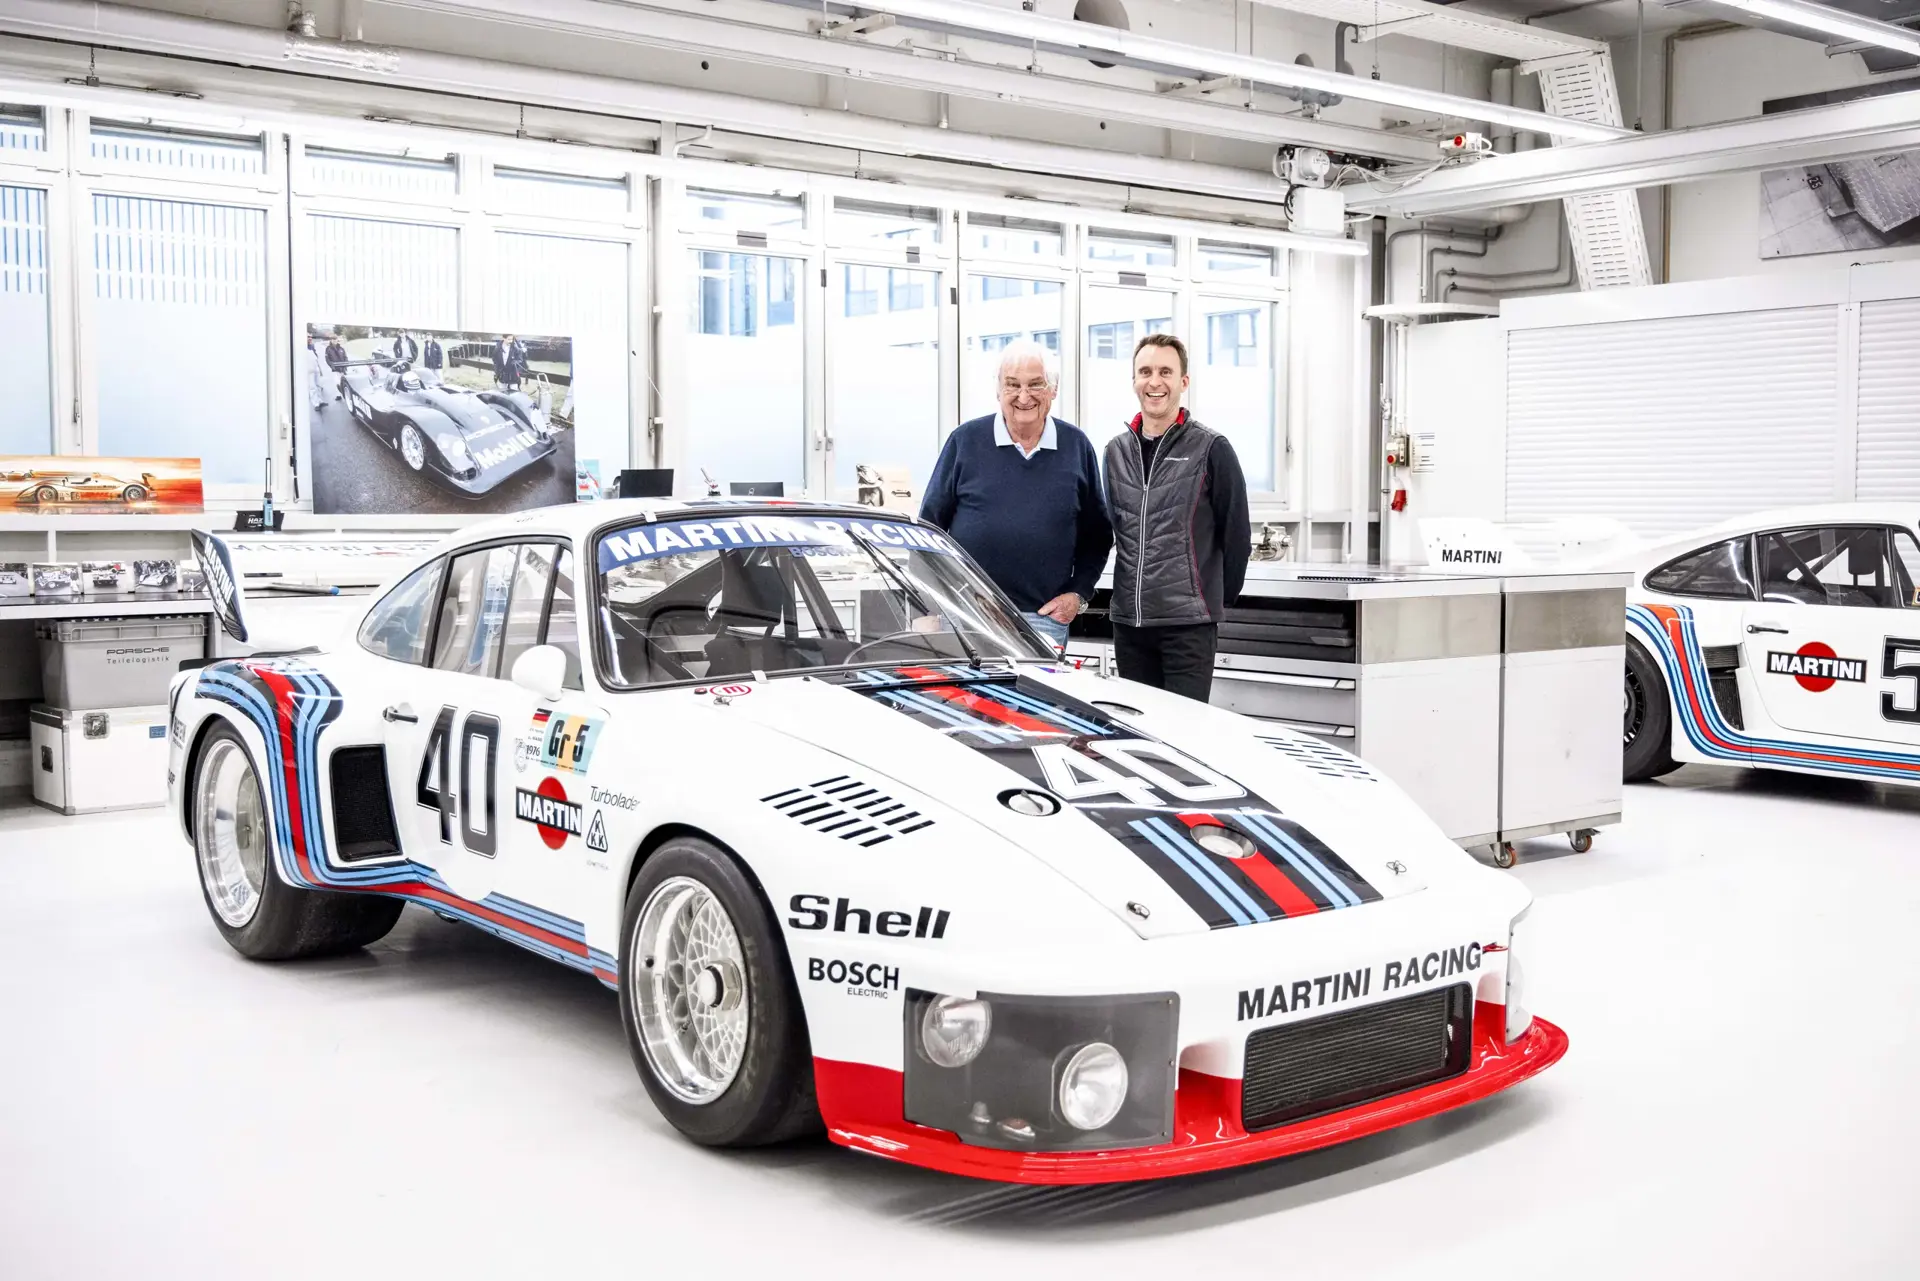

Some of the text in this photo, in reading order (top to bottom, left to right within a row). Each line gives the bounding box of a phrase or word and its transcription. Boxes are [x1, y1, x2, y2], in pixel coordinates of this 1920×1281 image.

[474, 436, 525, 469] Mobil
[204, 535, 235, 604] MARTINI
[1442, 549, 1502, 564] MARTINI
[107, 656, 169, 664] Teilelogistik
[1770, 653, 1863, 680] MARTINI
[526, 744, 541, 757] 1976
[548, 719, 590, 763] Gr 5
[416, 704, 501, 859] 40
[1031, 738, 1248, 805] 40
[590, 785, 640, 811] Turbolader
[788, 893, 951, 939] Shell
[808, 957, 899, 991] BOSCH
[1237, 941, 1481, 1021] MARTINI RACING
[847, 987, 888, 1000] ELECTRIC
